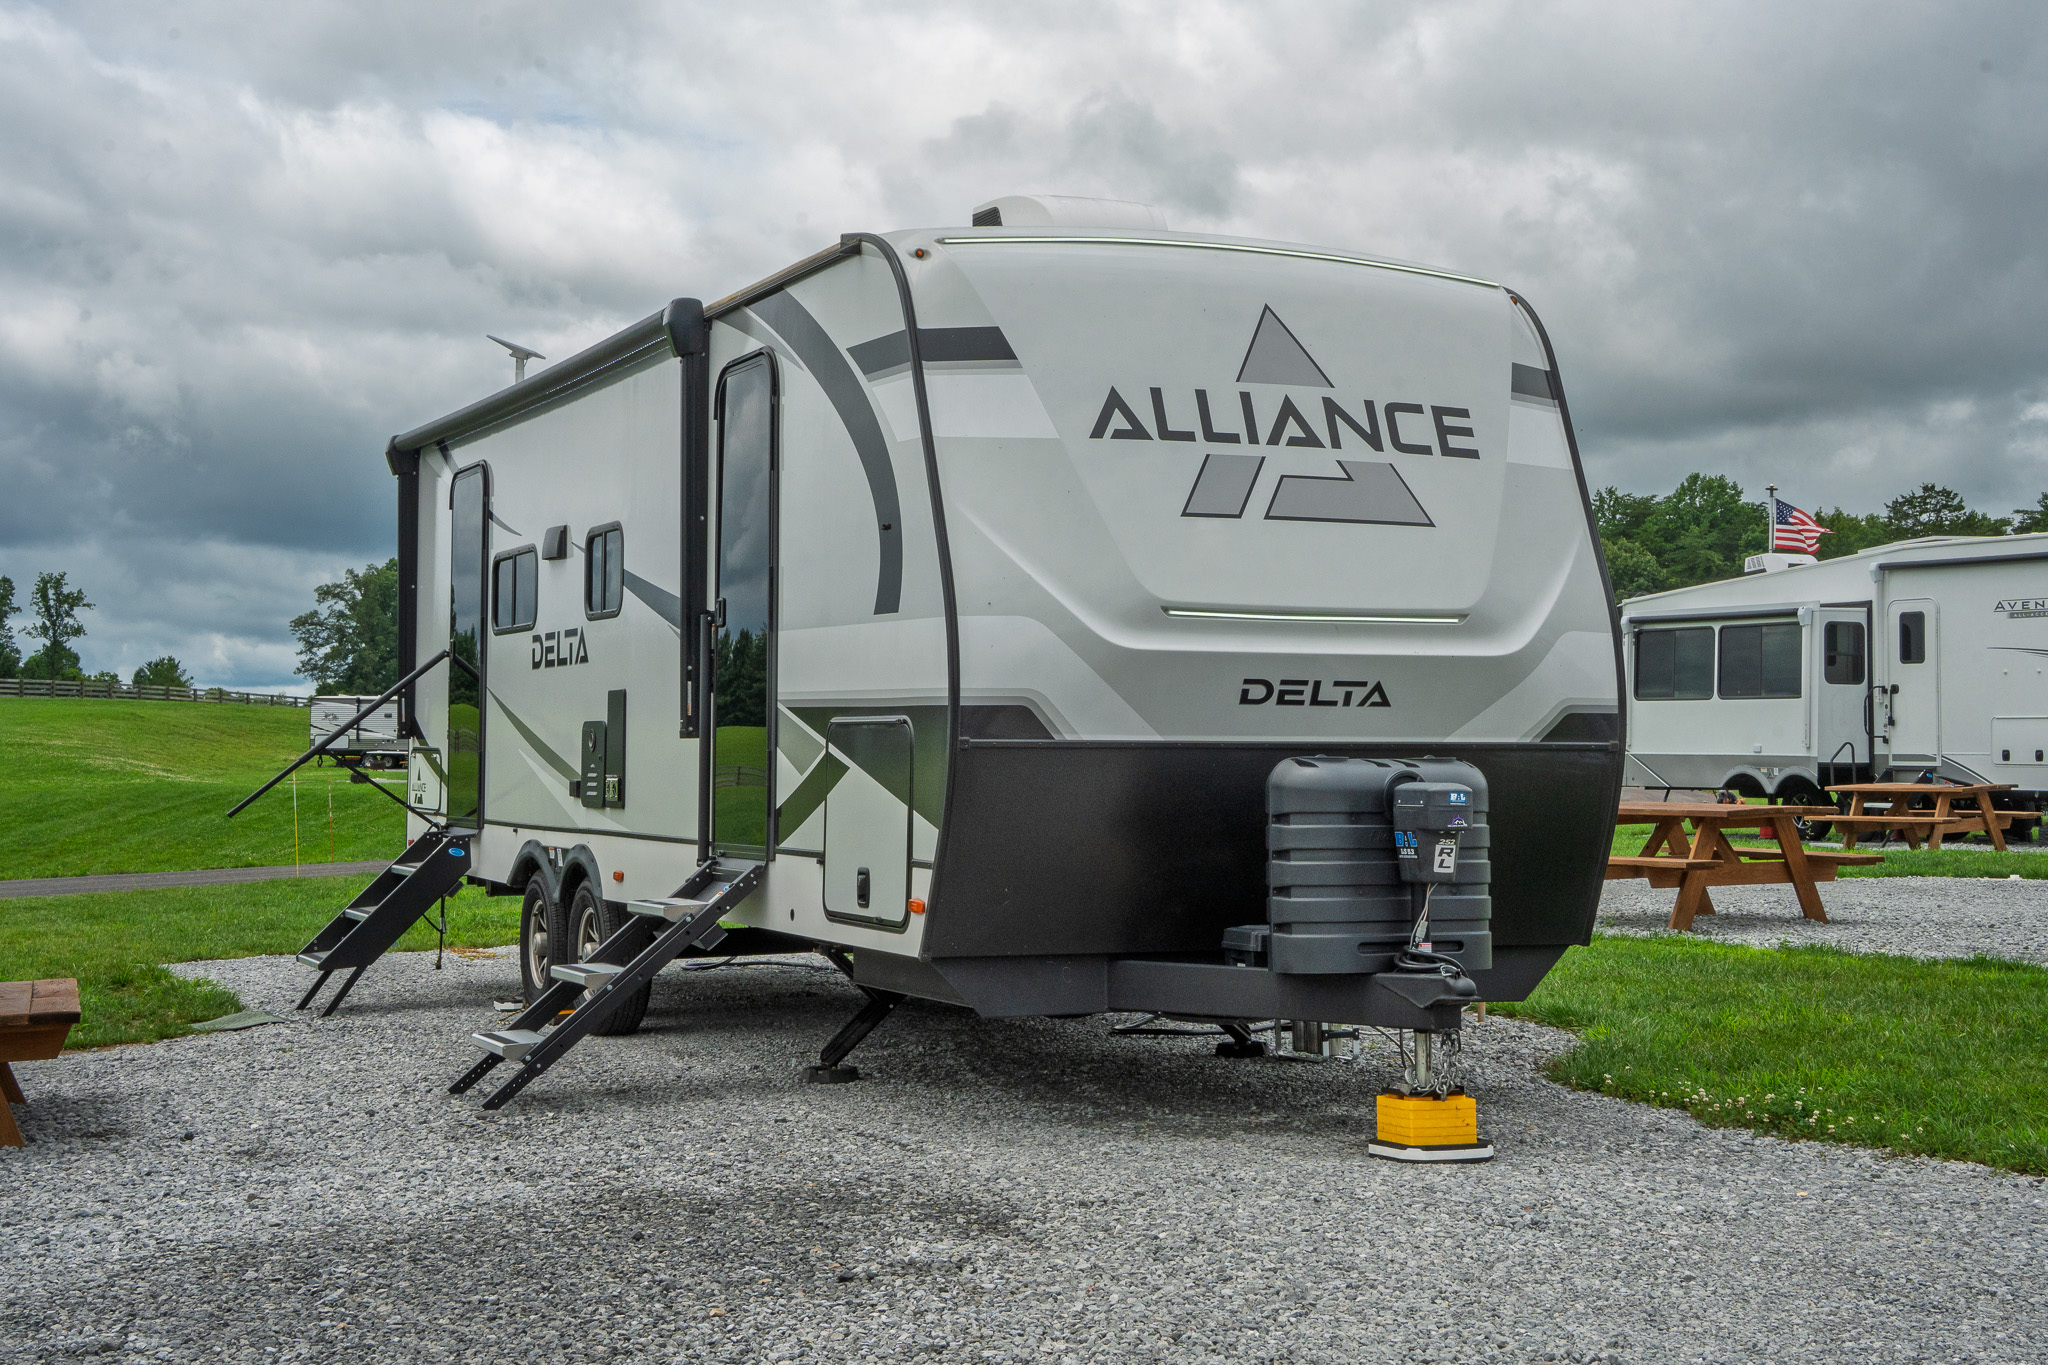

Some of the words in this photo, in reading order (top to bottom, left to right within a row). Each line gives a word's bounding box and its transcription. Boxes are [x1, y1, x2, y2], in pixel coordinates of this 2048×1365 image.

[1089, 385, 1480, 459] ALLIANCE
[532, 626, 589, 670] DELTA
[1239, 678, 1392, 707] DELTA
